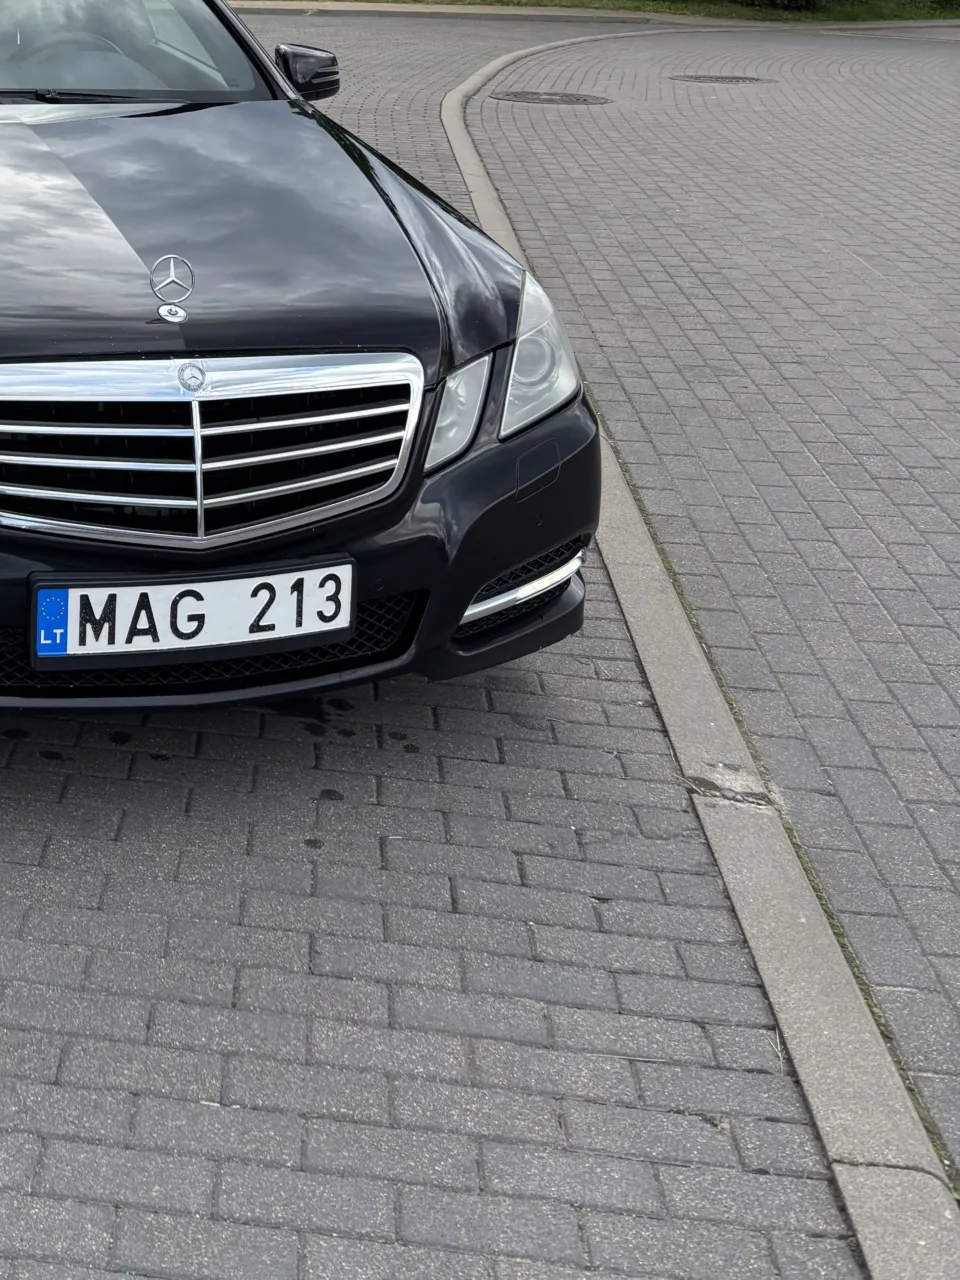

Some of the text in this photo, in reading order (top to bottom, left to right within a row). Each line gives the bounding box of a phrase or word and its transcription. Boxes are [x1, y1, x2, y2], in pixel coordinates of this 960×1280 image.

[78, 573, 342, 647] MAG 213
[40, 629, 65, 644] LT
